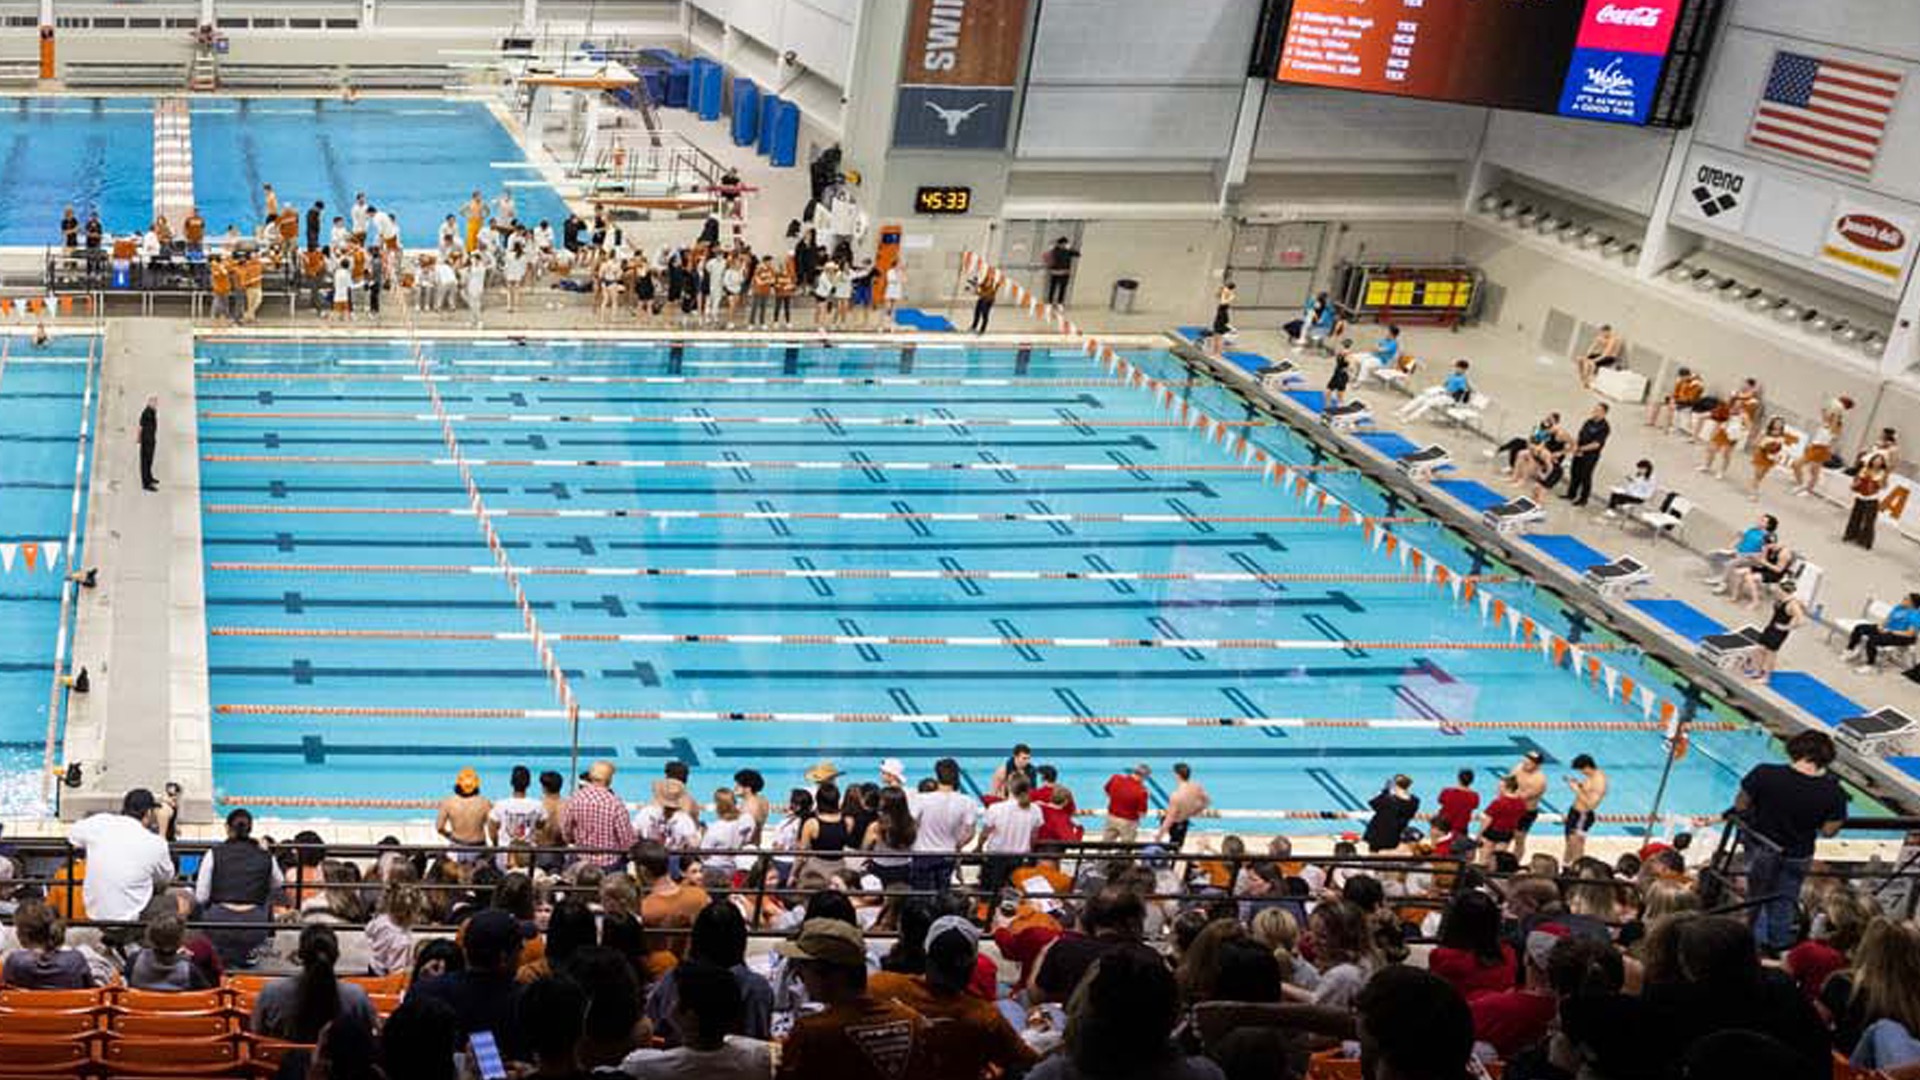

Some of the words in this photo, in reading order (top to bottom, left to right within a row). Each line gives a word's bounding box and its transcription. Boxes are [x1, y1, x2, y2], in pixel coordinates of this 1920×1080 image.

[924, 0, 964, 71] SWI
[1697, 165, 1744, 194] arena
[922, 192, 967, 210] 45:33
